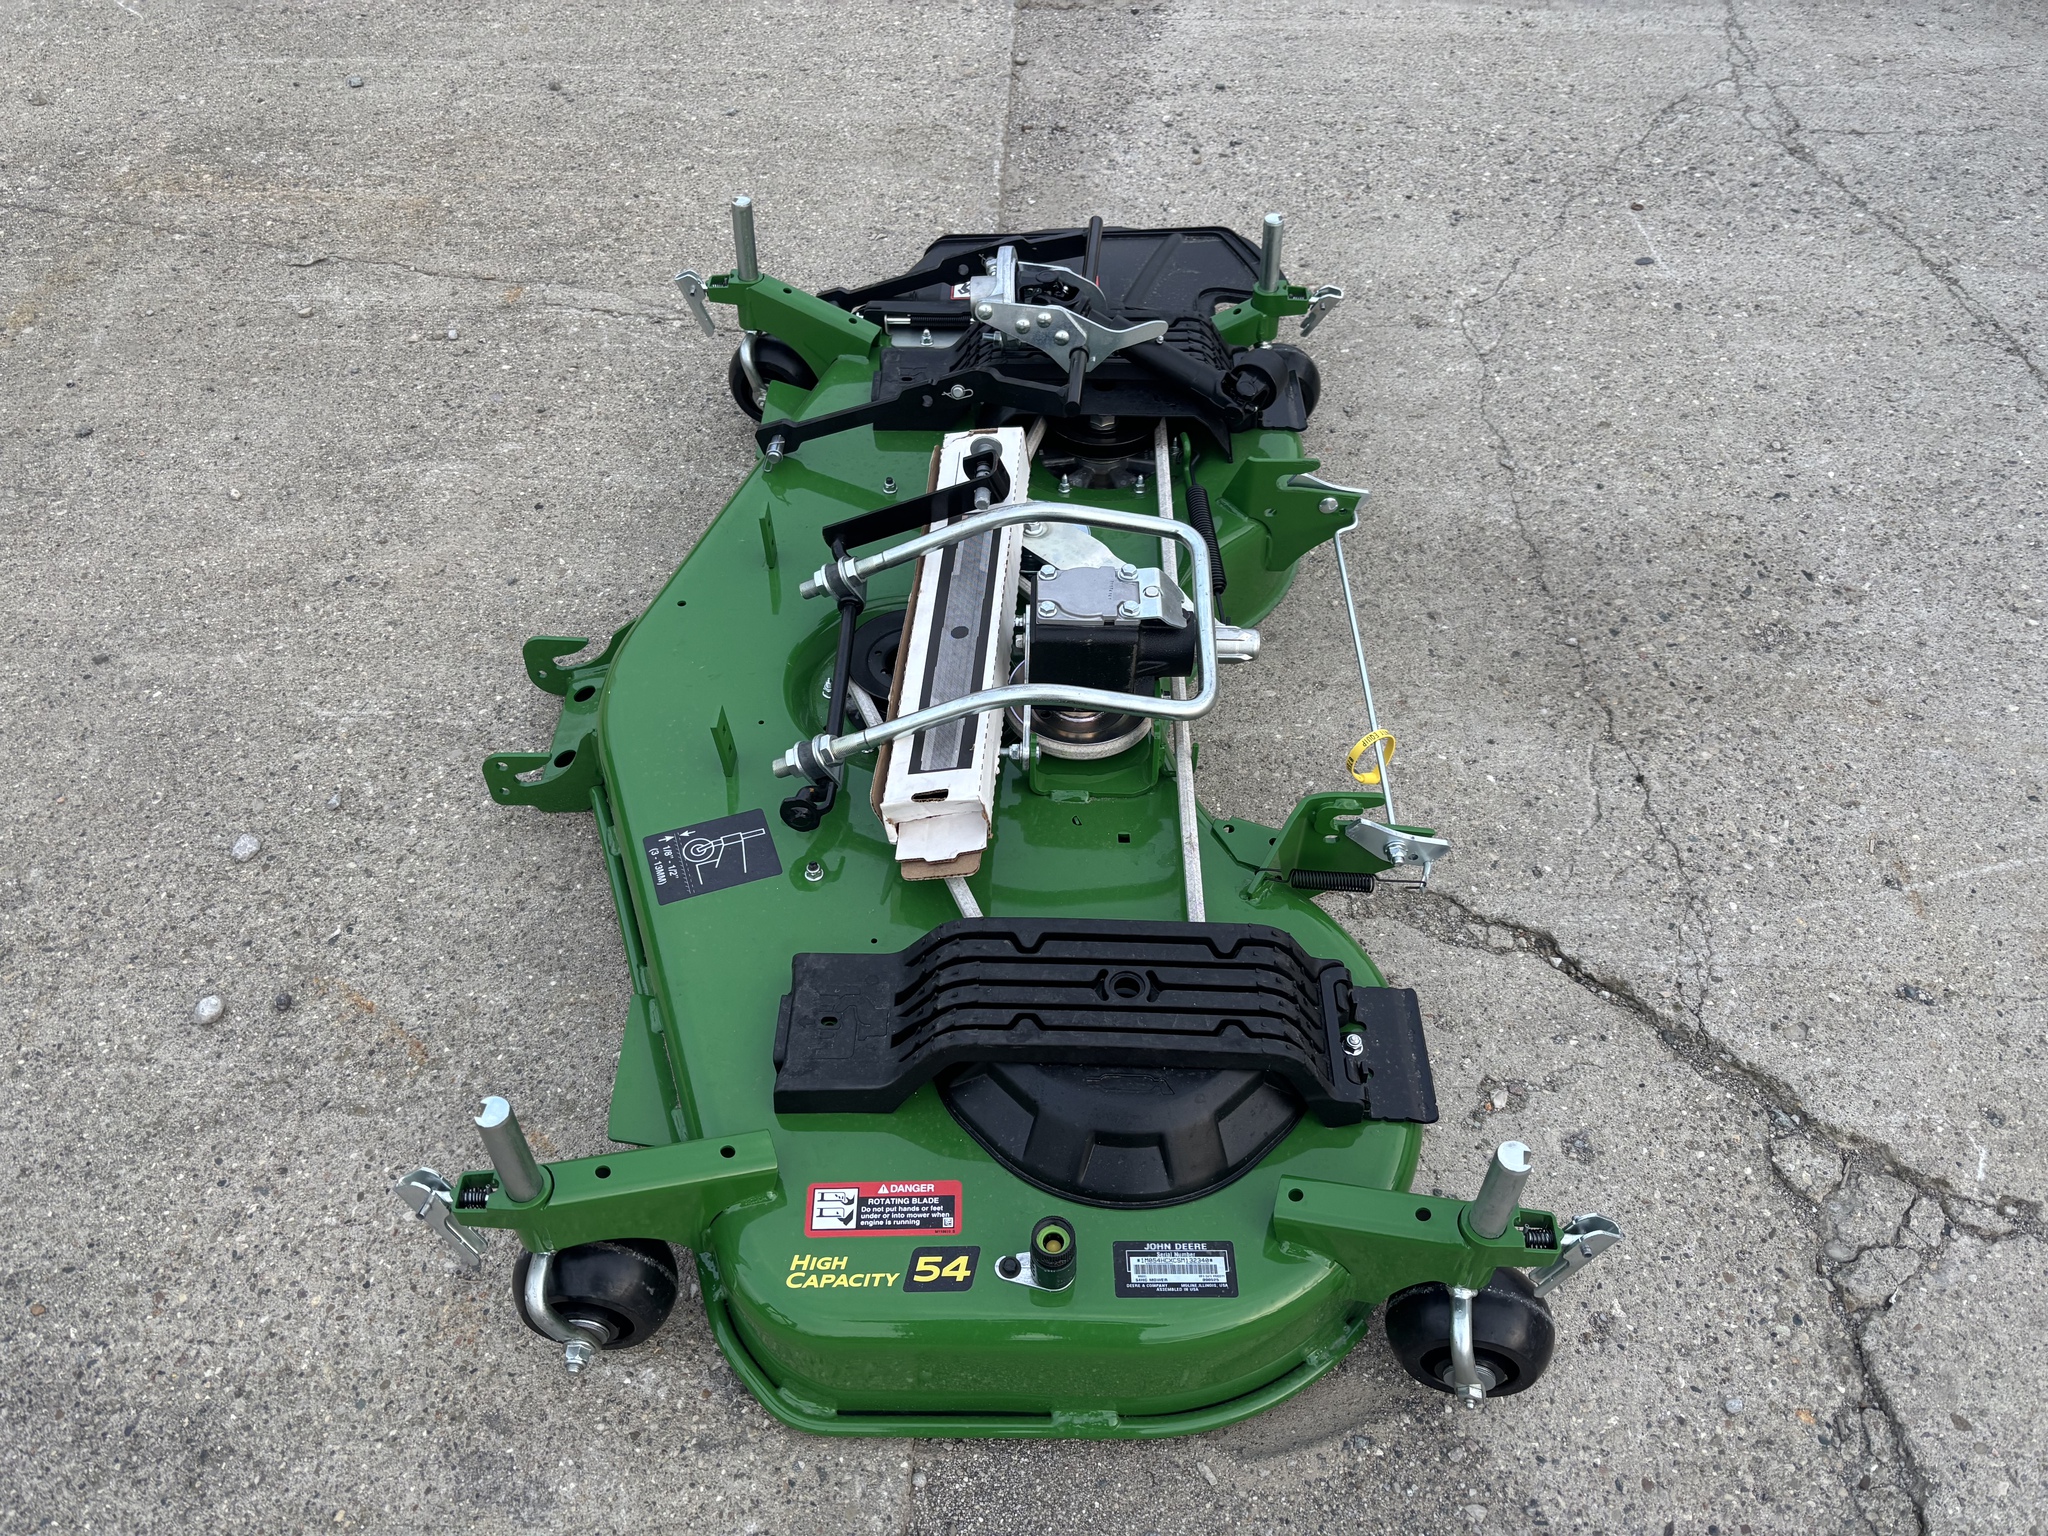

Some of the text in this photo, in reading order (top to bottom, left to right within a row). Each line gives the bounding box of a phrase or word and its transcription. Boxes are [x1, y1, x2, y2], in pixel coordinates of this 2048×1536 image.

[1361, 732, 1380, 747] EQUIP
[653, 860, 667, 886] 13MM)
[890, 1183, 935, 1193] DANGER
[868, 1197, 910, 1205] ROTATING
[860, 1219, 884, 1227] engine
[893, 1218, 921, 1227] running
[790, 1254, 849, 1271] HIGH
[913, 1255, 972, 1283] 54
[785, 1272, 900, 1289] CAPACITY
